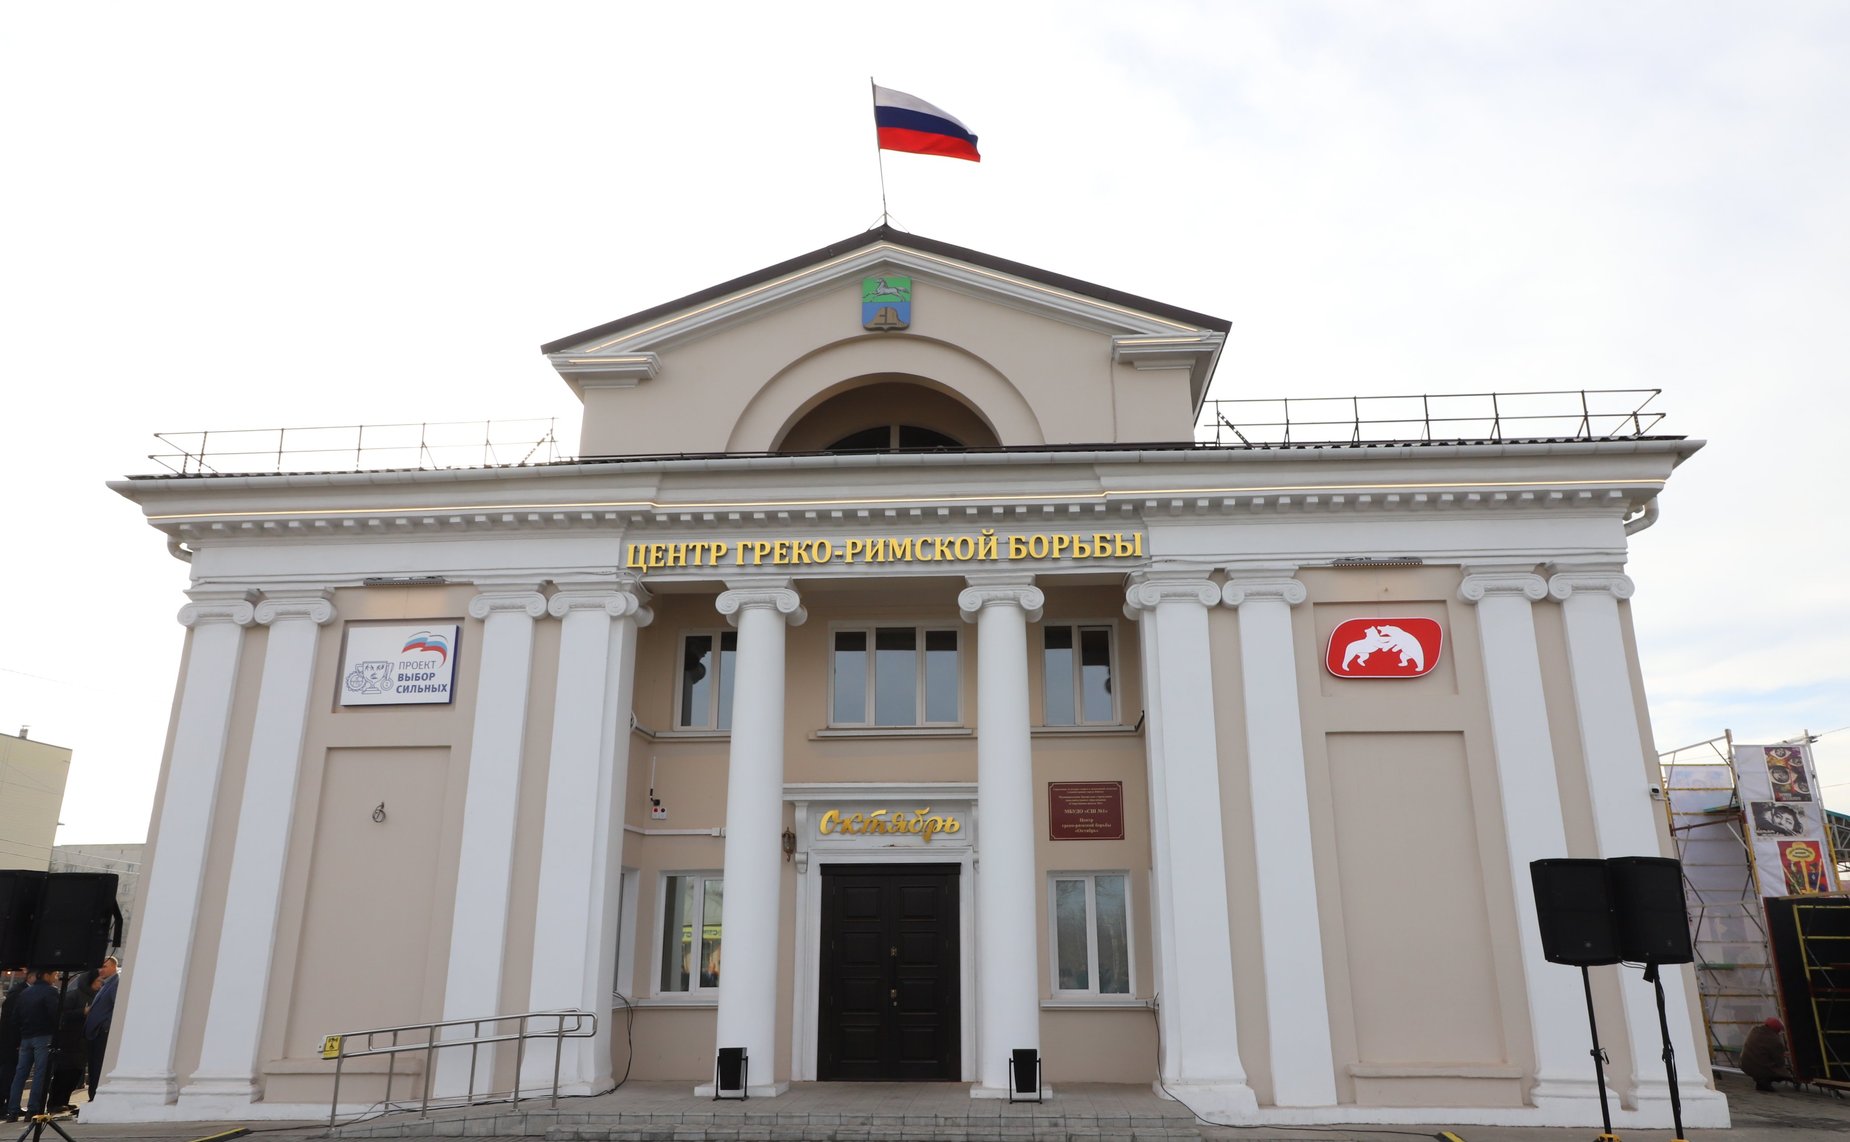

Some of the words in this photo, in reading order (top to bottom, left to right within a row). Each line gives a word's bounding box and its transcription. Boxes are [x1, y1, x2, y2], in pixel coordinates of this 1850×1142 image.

[626, 543, 728, 574] ЦЕНТР
[735, 529, 999, 566] ГРЕКО-РИМСКОЙ
[1007, 531, 1144, 560] БОРЬБЫ
[398, 661, 436, 670] ПРОЕКТ
[398, 672, 436, 682] ВЫБОР
[396, 684, 448, 693] СИЛЬНЫХ
[819, 806, 961, 844] Октябрь
